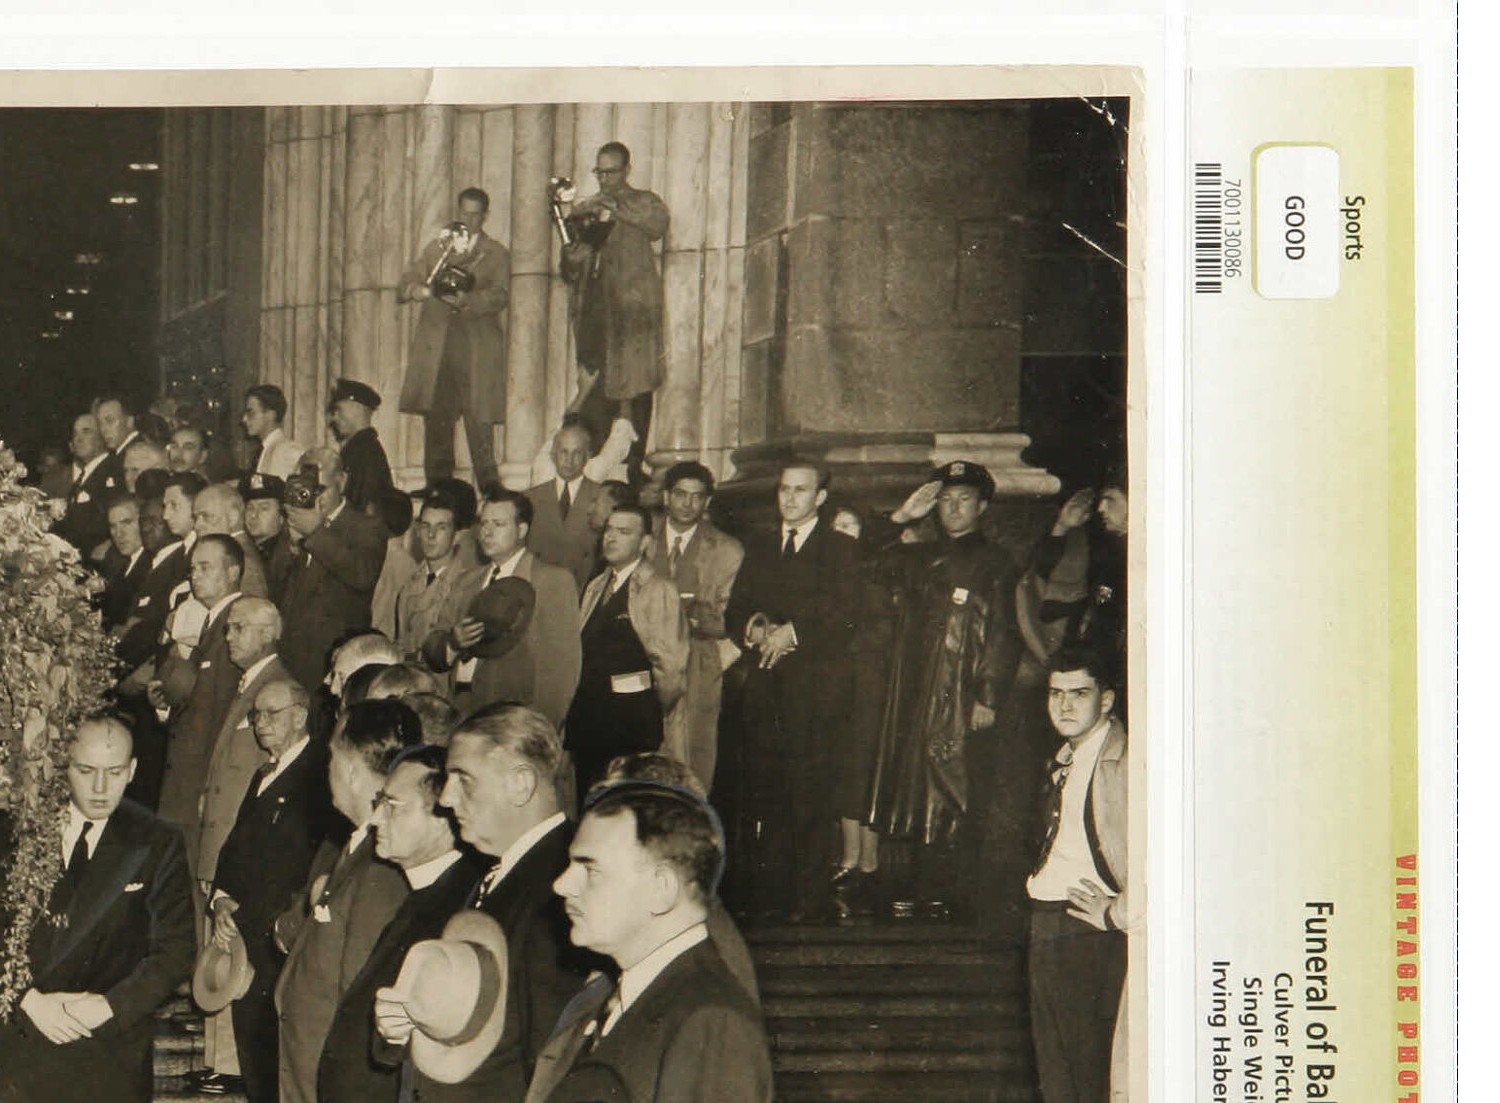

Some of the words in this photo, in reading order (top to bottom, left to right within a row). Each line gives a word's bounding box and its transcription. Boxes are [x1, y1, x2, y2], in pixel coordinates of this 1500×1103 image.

[1224, 178, 1242, 278] 7001130086
[1285, 195, 1305, 260] GOOD
[1340, 195, 1365, 260] Sports
[1305, 902, 1337, 1011] Funeral
[1396, 854, 1418, 1001] VINTAGE
[1208, 960, 1231, 1027] Irving
[1238, 977, 1263, 1048] Single
[1274, 972, 1294, 1046] Culver
[1306, 1022, 1338, 1053] of
